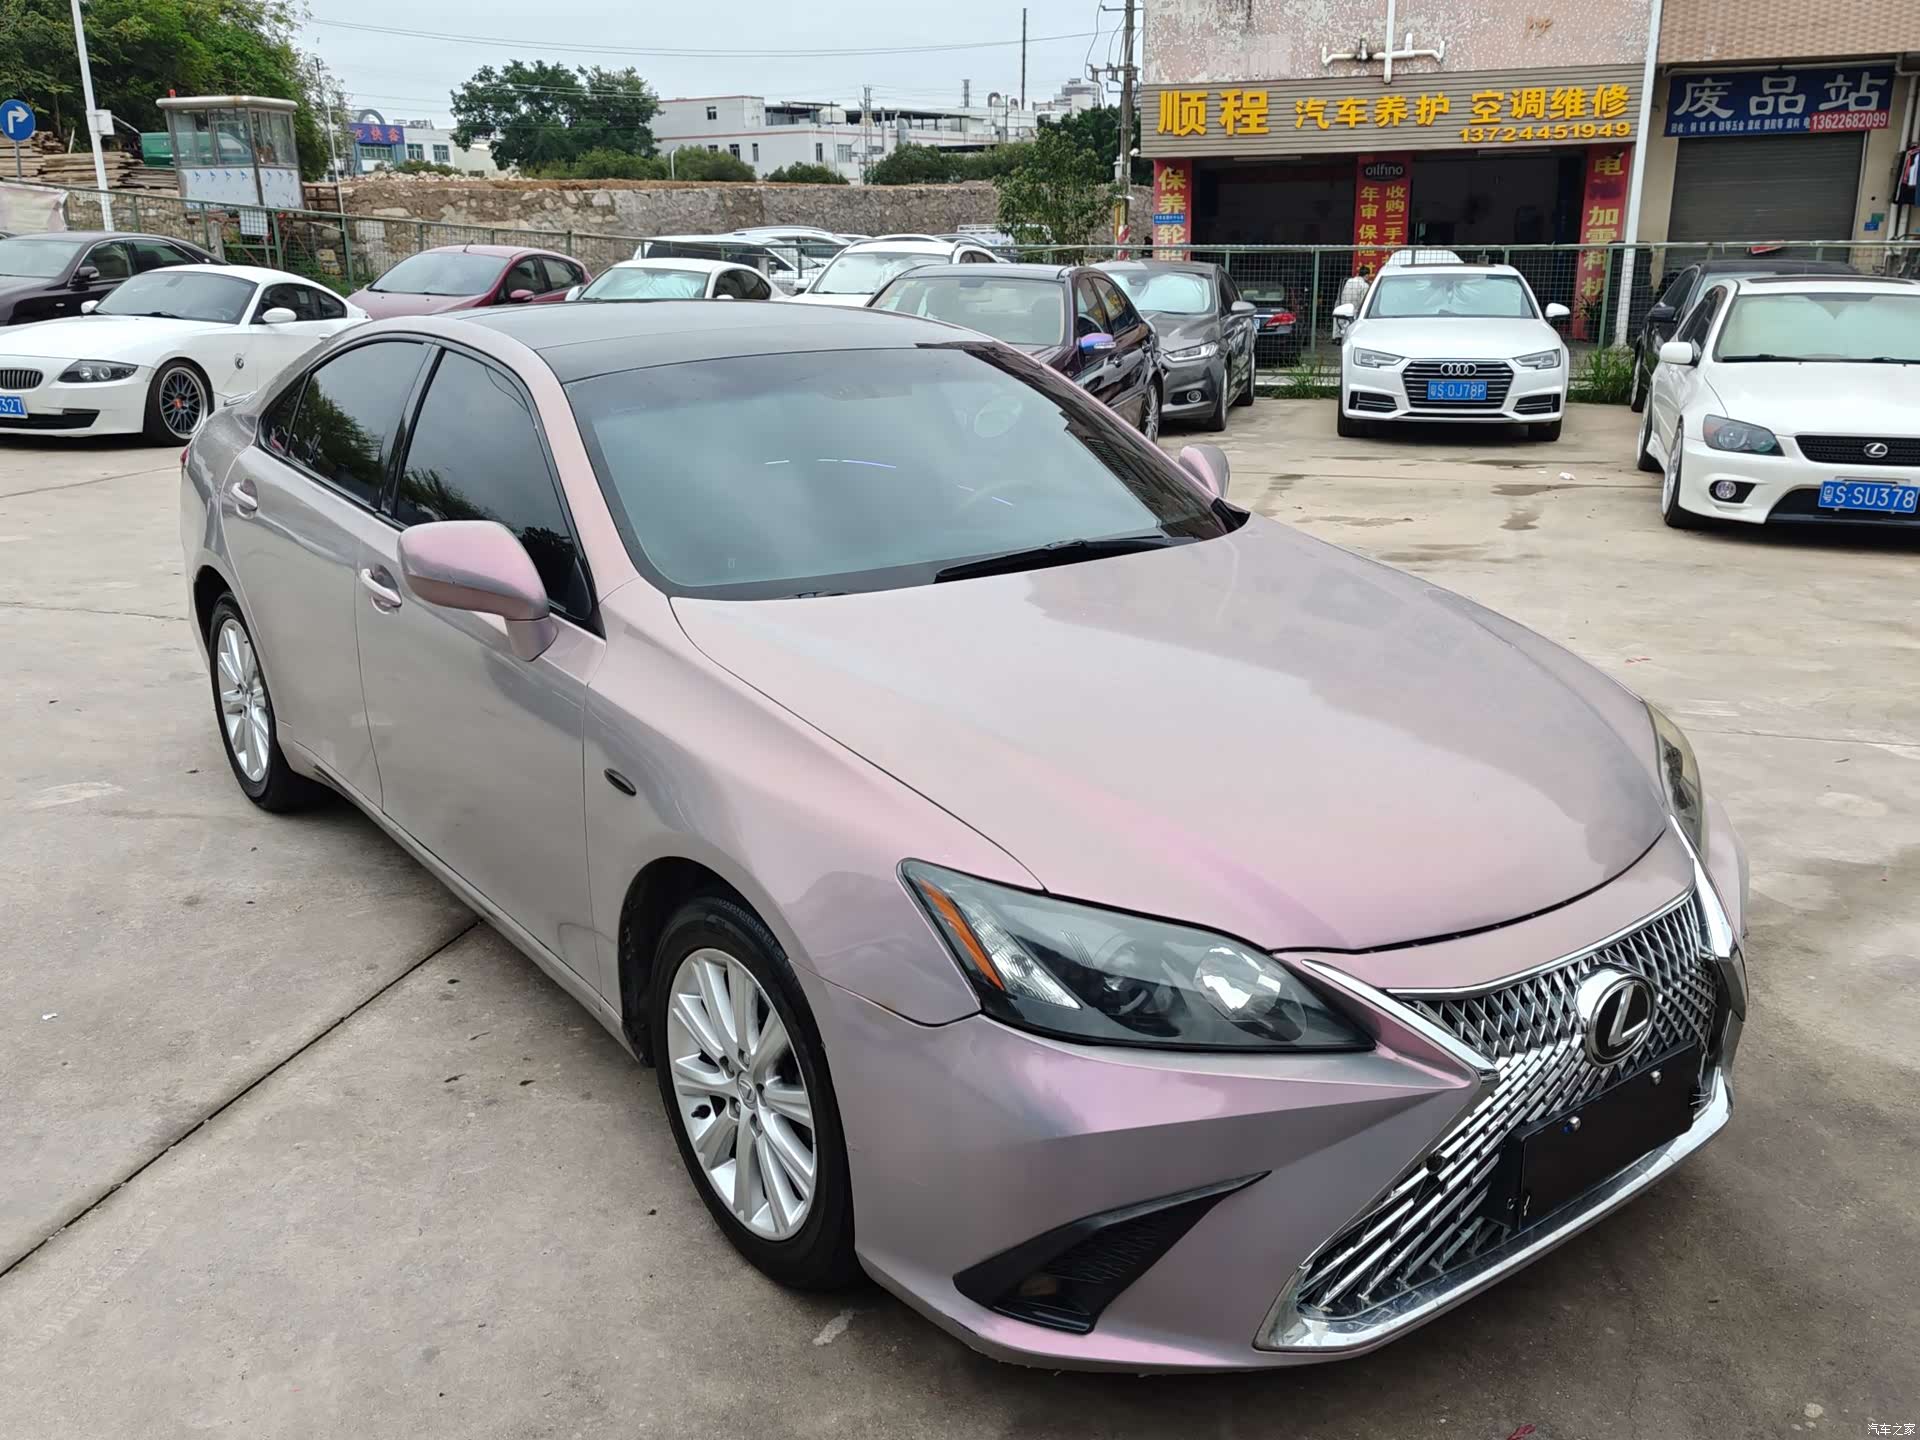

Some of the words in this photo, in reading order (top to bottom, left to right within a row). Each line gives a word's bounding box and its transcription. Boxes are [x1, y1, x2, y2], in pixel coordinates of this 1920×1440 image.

[1674, 72, 1889, 118] 废品站
[1157, 89, 1270, 136] 顺程
[1295, 92, 1450, 130] 汽车养护
[1469, 83, 1631, 125] 空调维修
[1812, 112, 1888, 130] 13622682099
[1459, 122, 1632, 143] 13724451949
[0, 398, 22, 413] 327
